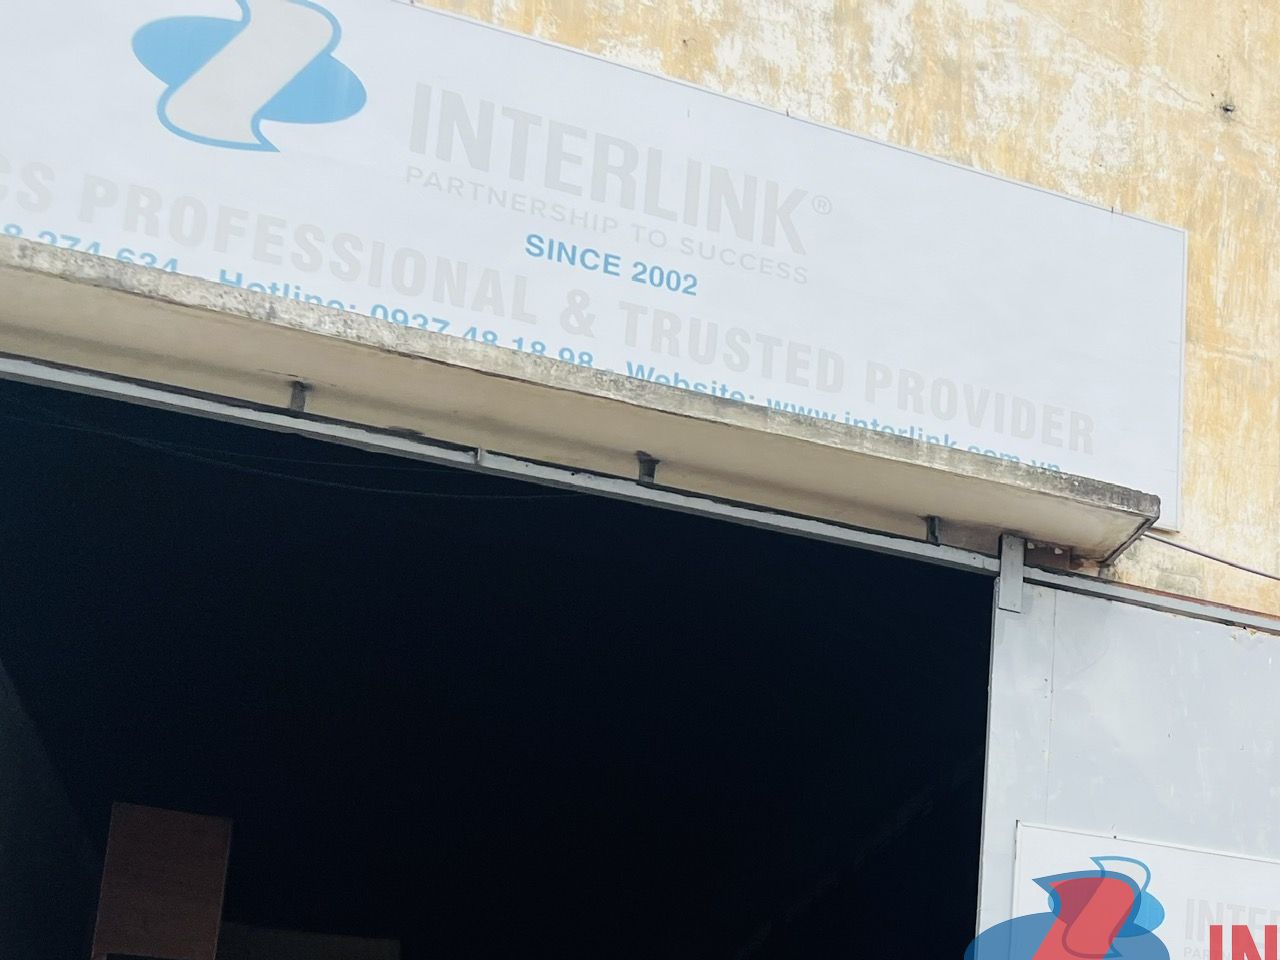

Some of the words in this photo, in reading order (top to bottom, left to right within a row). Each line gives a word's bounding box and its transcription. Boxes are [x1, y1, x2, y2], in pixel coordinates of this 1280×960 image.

[406, 165, 618, 235] PARTNERSHIP
[631, 222, 668, 250] TO
[680, 237, 808, 285] SUCCESS
[525, 233, 621, 277] SINCE
[631, 261, 698, 297] 2002
[78, 173, 537, 325] PROFESSIONAL
[560, 288, 597, 340] &
[619, 300, 845, 394] TRUSTED
[863, 359, 1095, 454] PROVIDER
